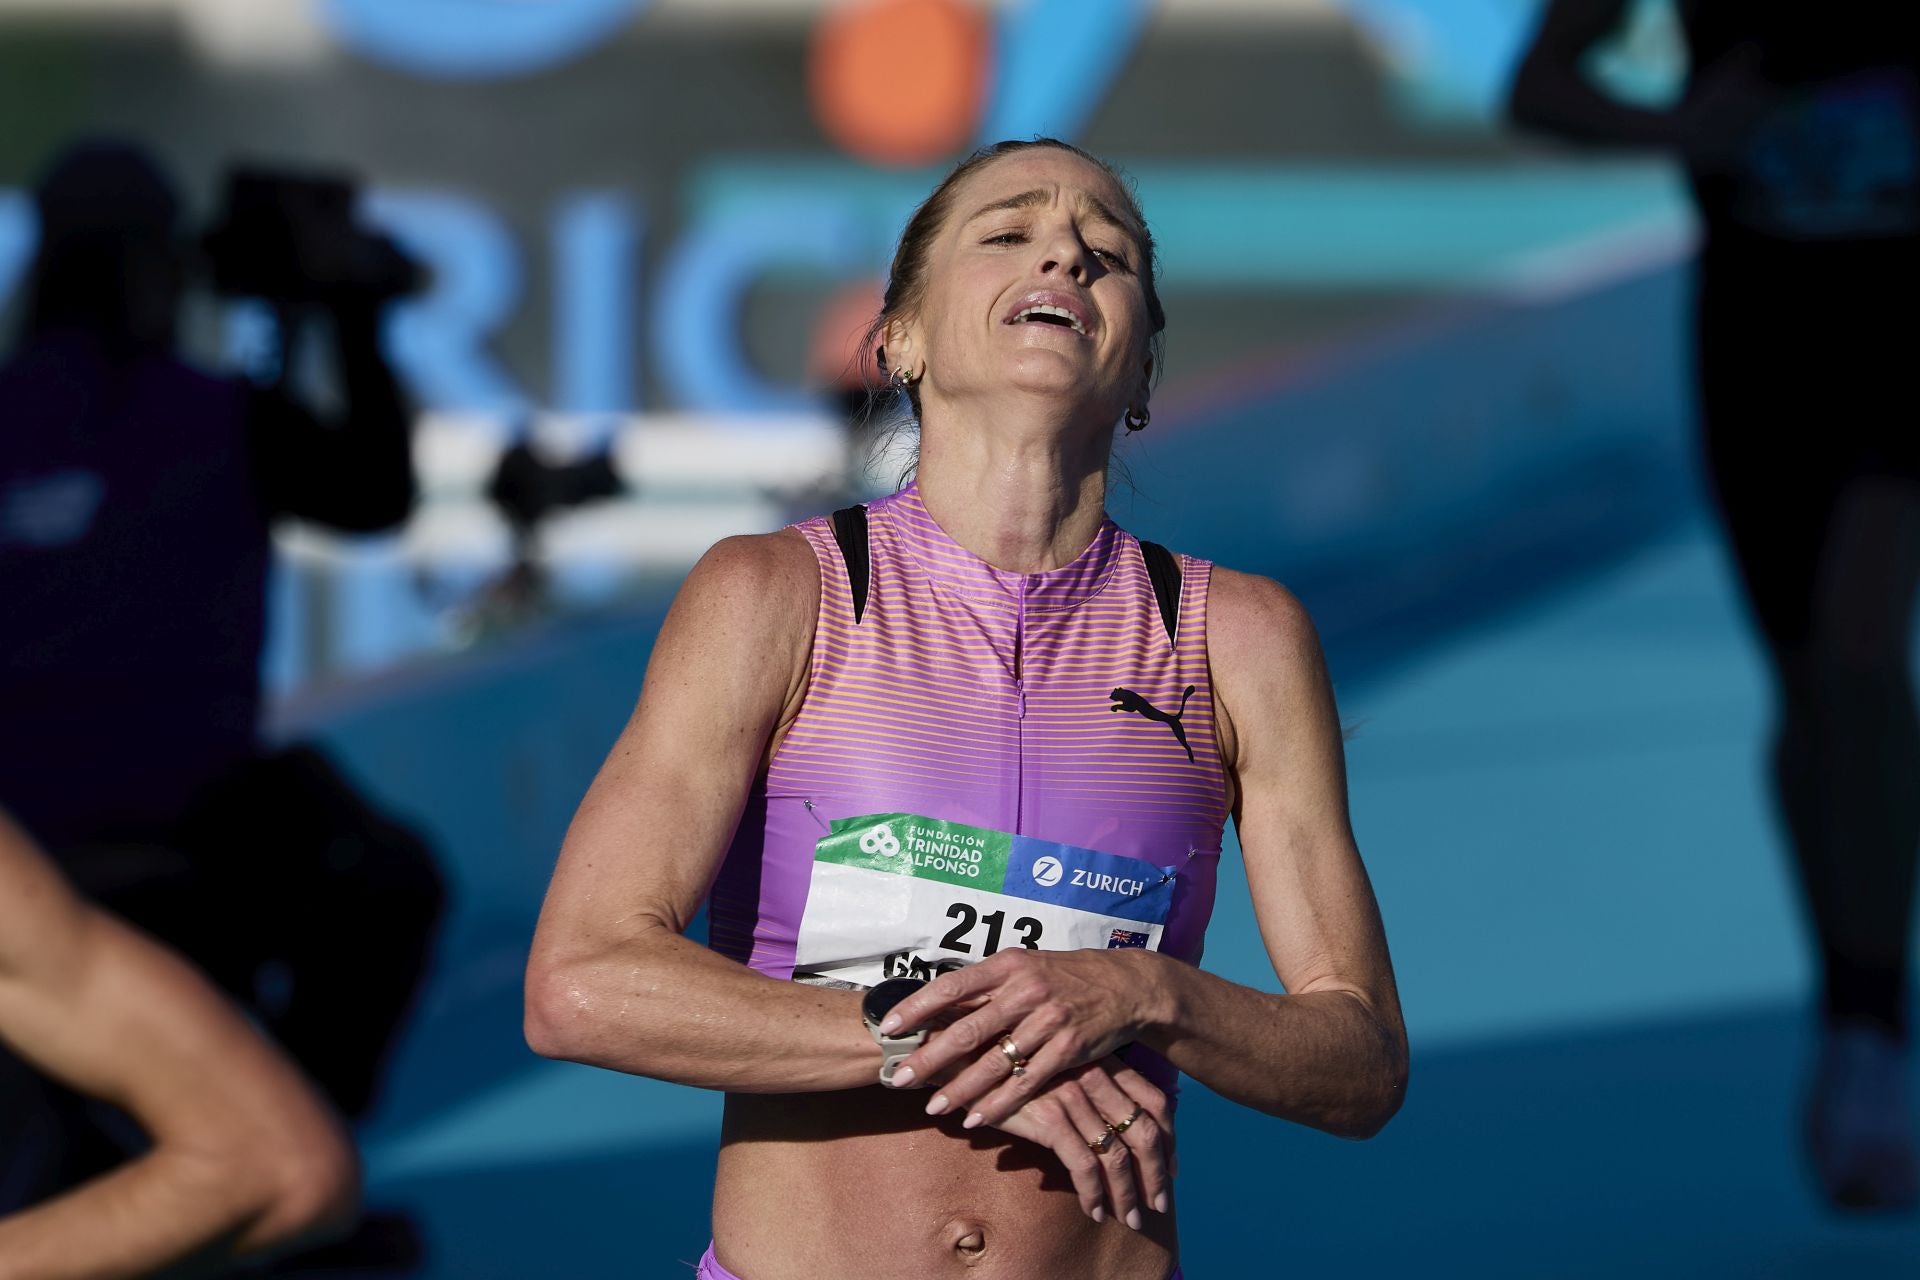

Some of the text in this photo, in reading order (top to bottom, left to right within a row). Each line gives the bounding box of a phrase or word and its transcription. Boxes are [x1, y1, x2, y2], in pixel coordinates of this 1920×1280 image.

[228, 188, 885, 412] RIC
[906, 835, 983, 863] TRINIDAD
[909, 826, 985, 848] FUNDACIÓN
[903, 851, 980, 878] ALFONSO
[1070, 869, 1144, 897] ZURICH
[939, 903, 1043, 957] 213
